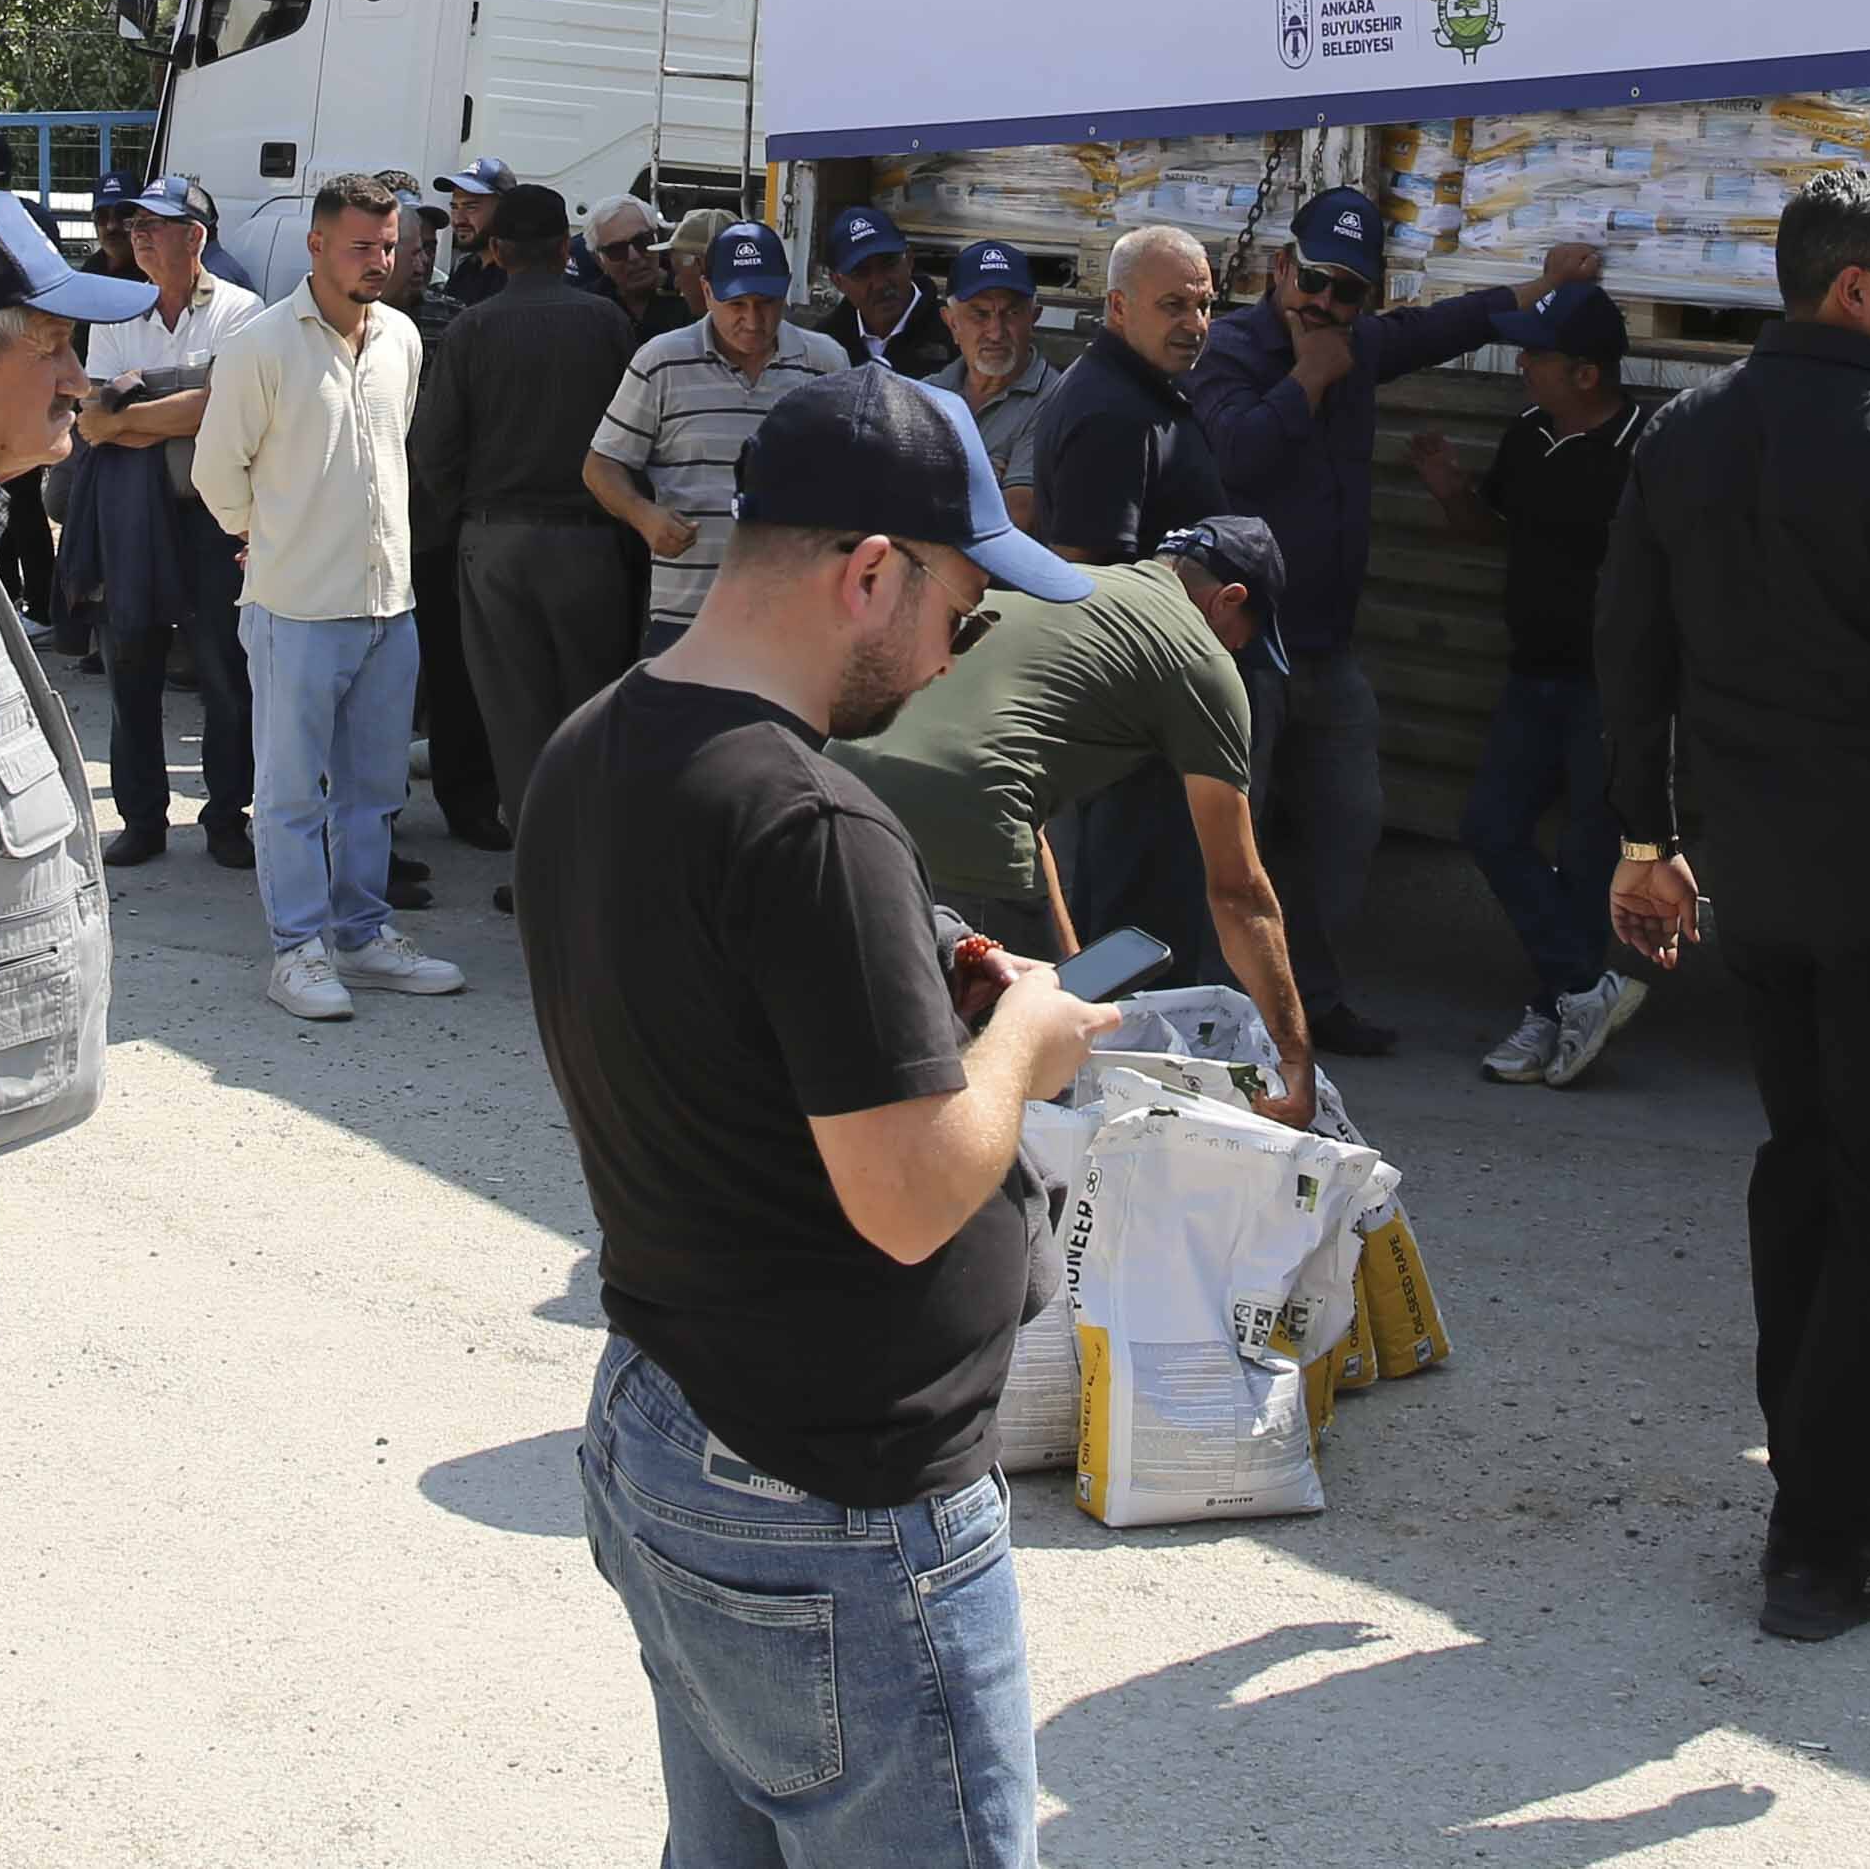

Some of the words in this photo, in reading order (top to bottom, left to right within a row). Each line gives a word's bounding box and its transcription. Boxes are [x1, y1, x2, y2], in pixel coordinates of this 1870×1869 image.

[1321, 0, 1375, 17] ANKARA
[1389, 1233, 1409, 1273] RAPE
[1401, 1273, 1425, 1335] OILSEED
